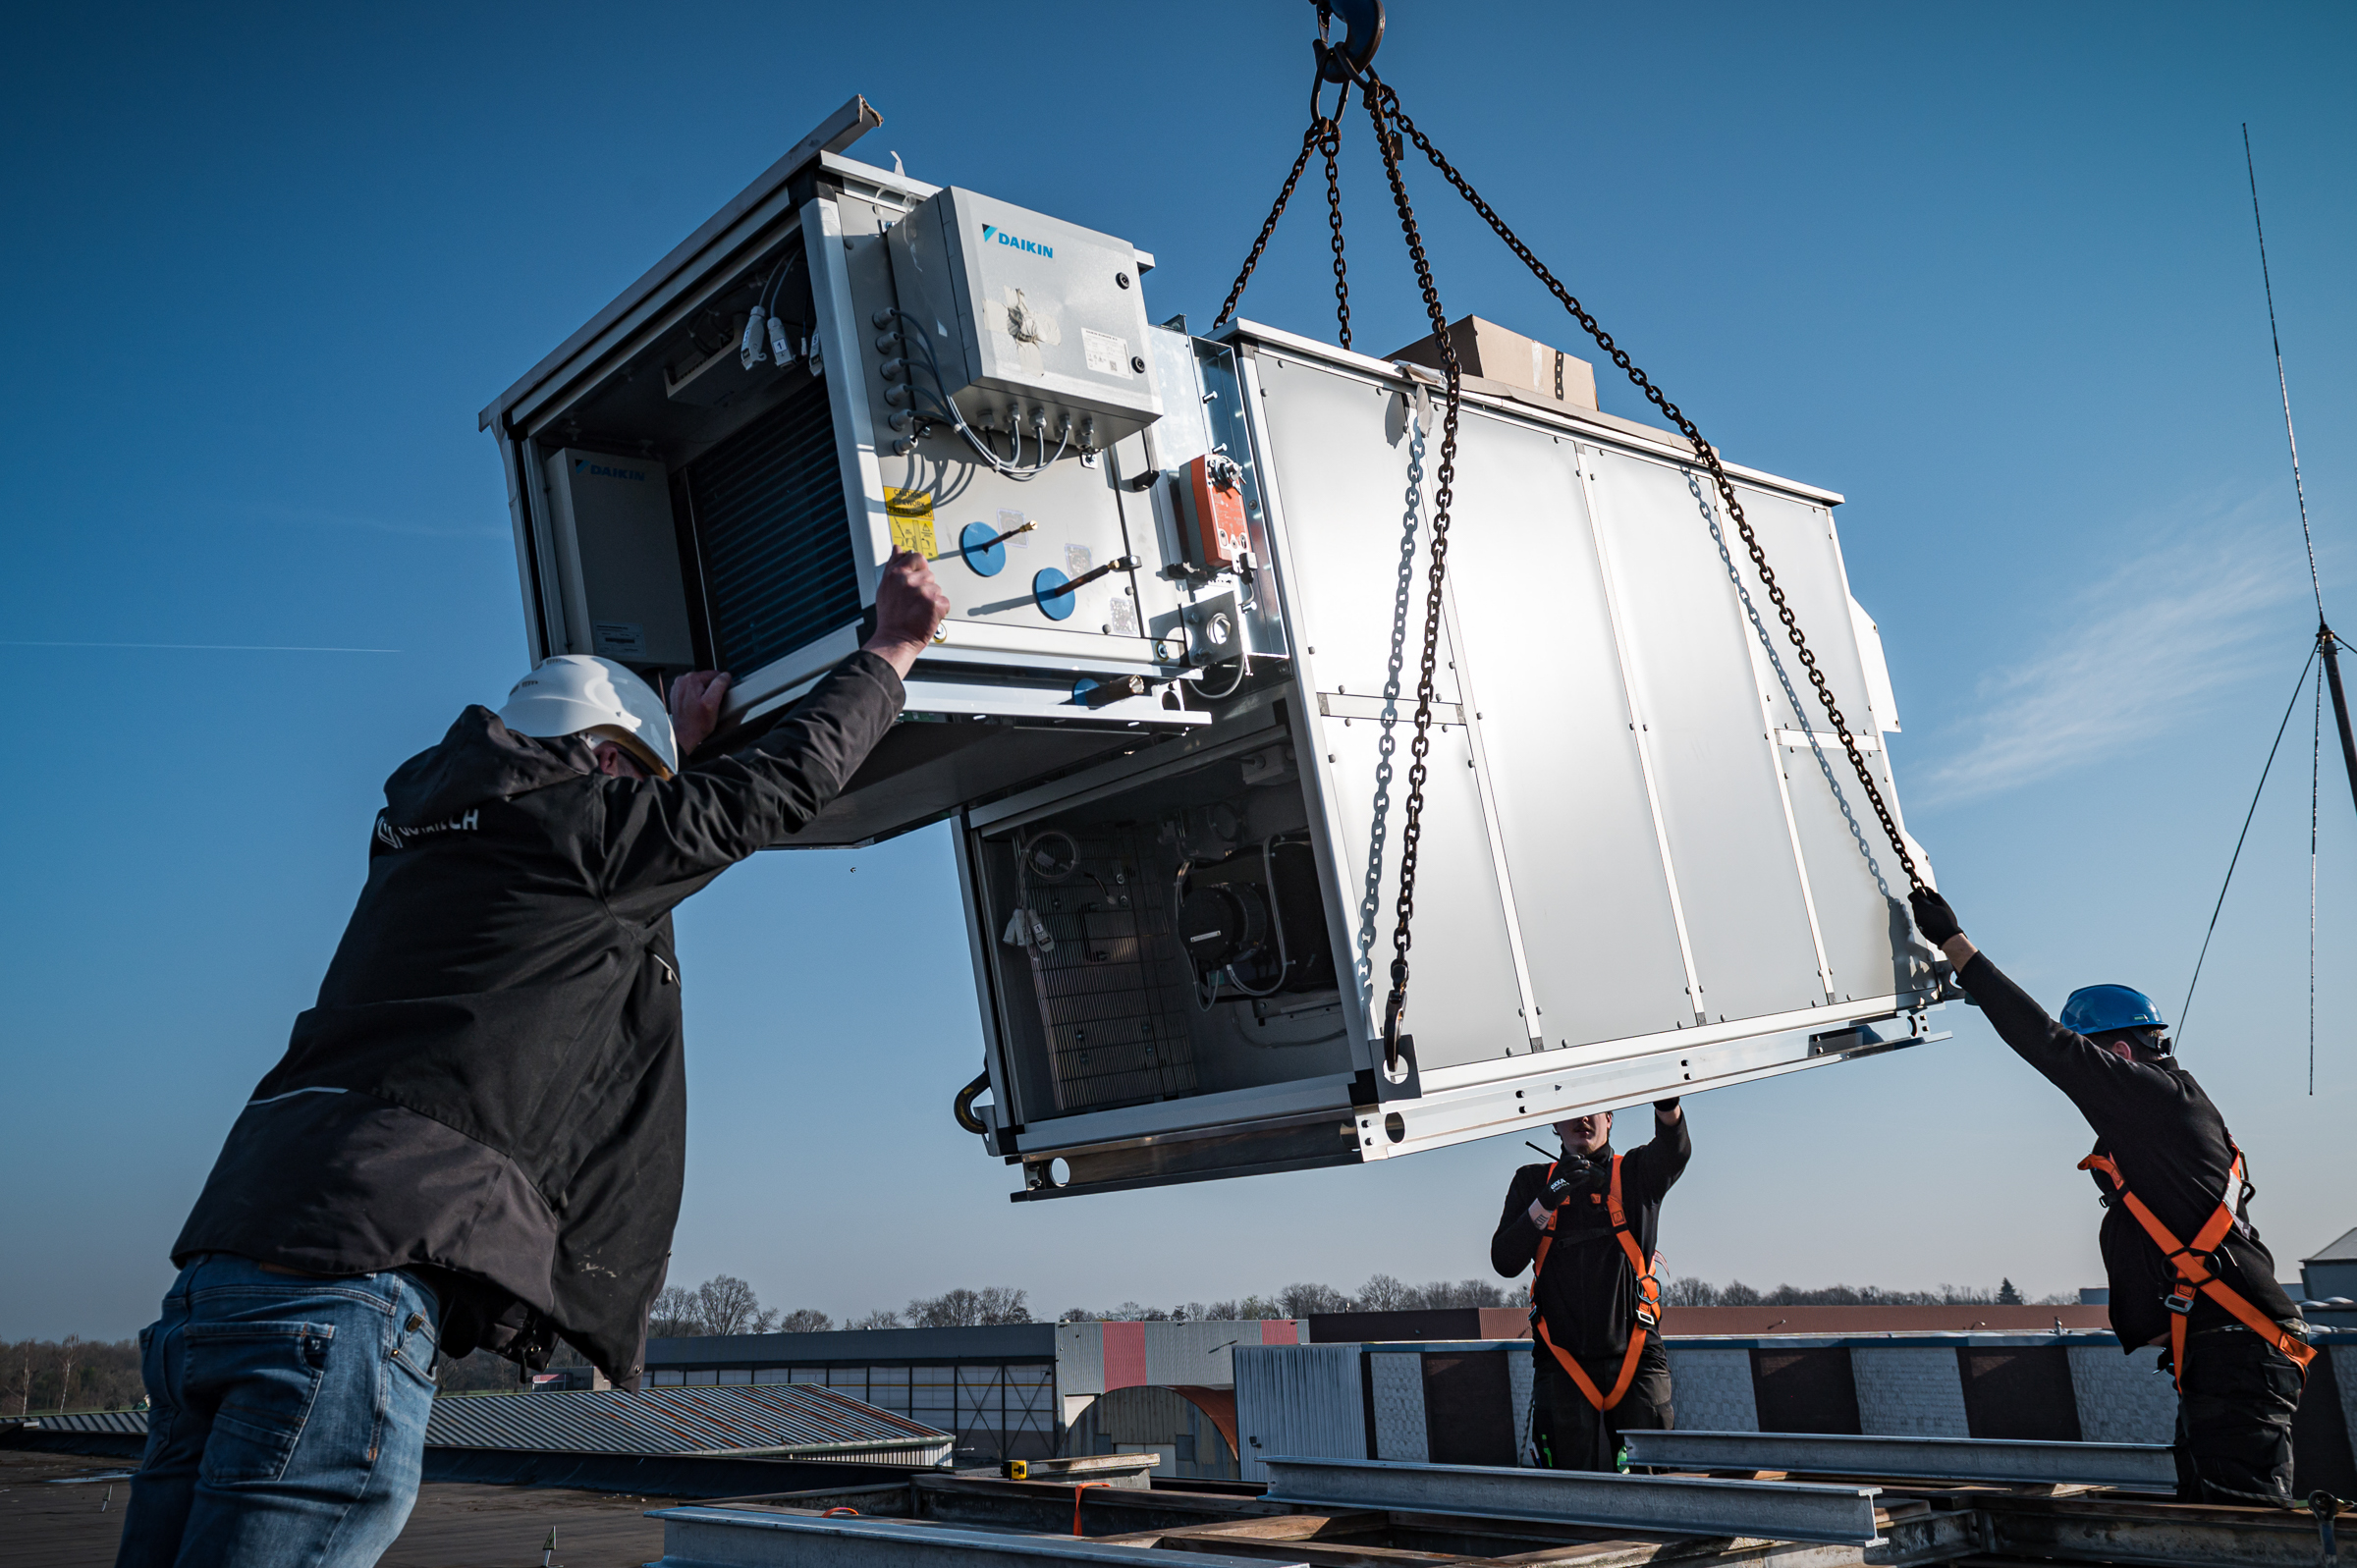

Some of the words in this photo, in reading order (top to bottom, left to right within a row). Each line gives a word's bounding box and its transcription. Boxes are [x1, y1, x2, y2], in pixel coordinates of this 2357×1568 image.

[998, 232, 1054, 259] DAIKIN
[590, 464, 645, 481] DAIKIN
[893, 488, 922, 499] CAUTION
[892, 498, 926, 508] PIPEWORK
